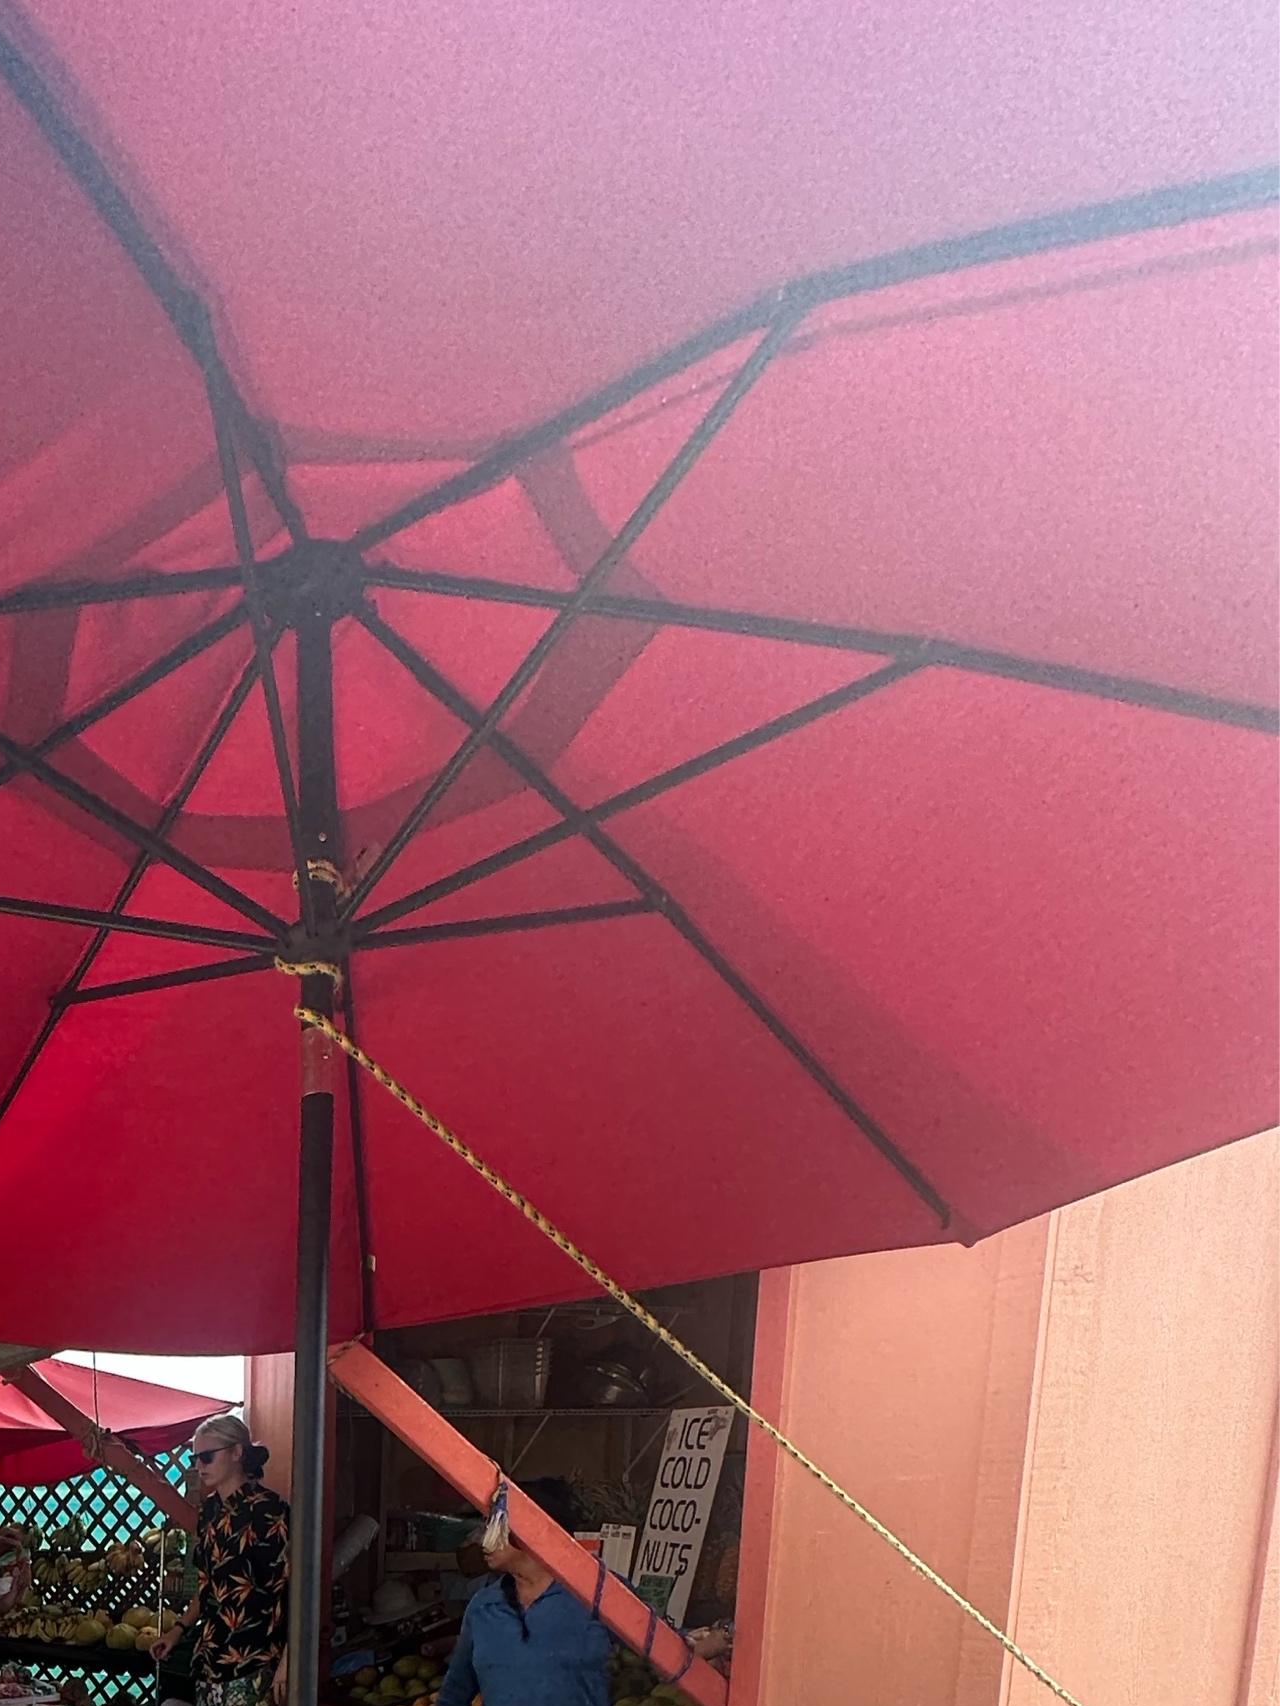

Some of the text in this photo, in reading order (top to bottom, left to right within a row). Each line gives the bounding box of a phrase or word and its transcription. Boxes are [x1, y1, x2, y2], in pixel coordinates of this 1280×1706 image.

[678, 1417, 712, 1450] ICE
[660, 1456, 711, 1489] COLD
[649, 1499, 701, 1533] COCO-
[640, 1539, 692, 1577] NUTS
